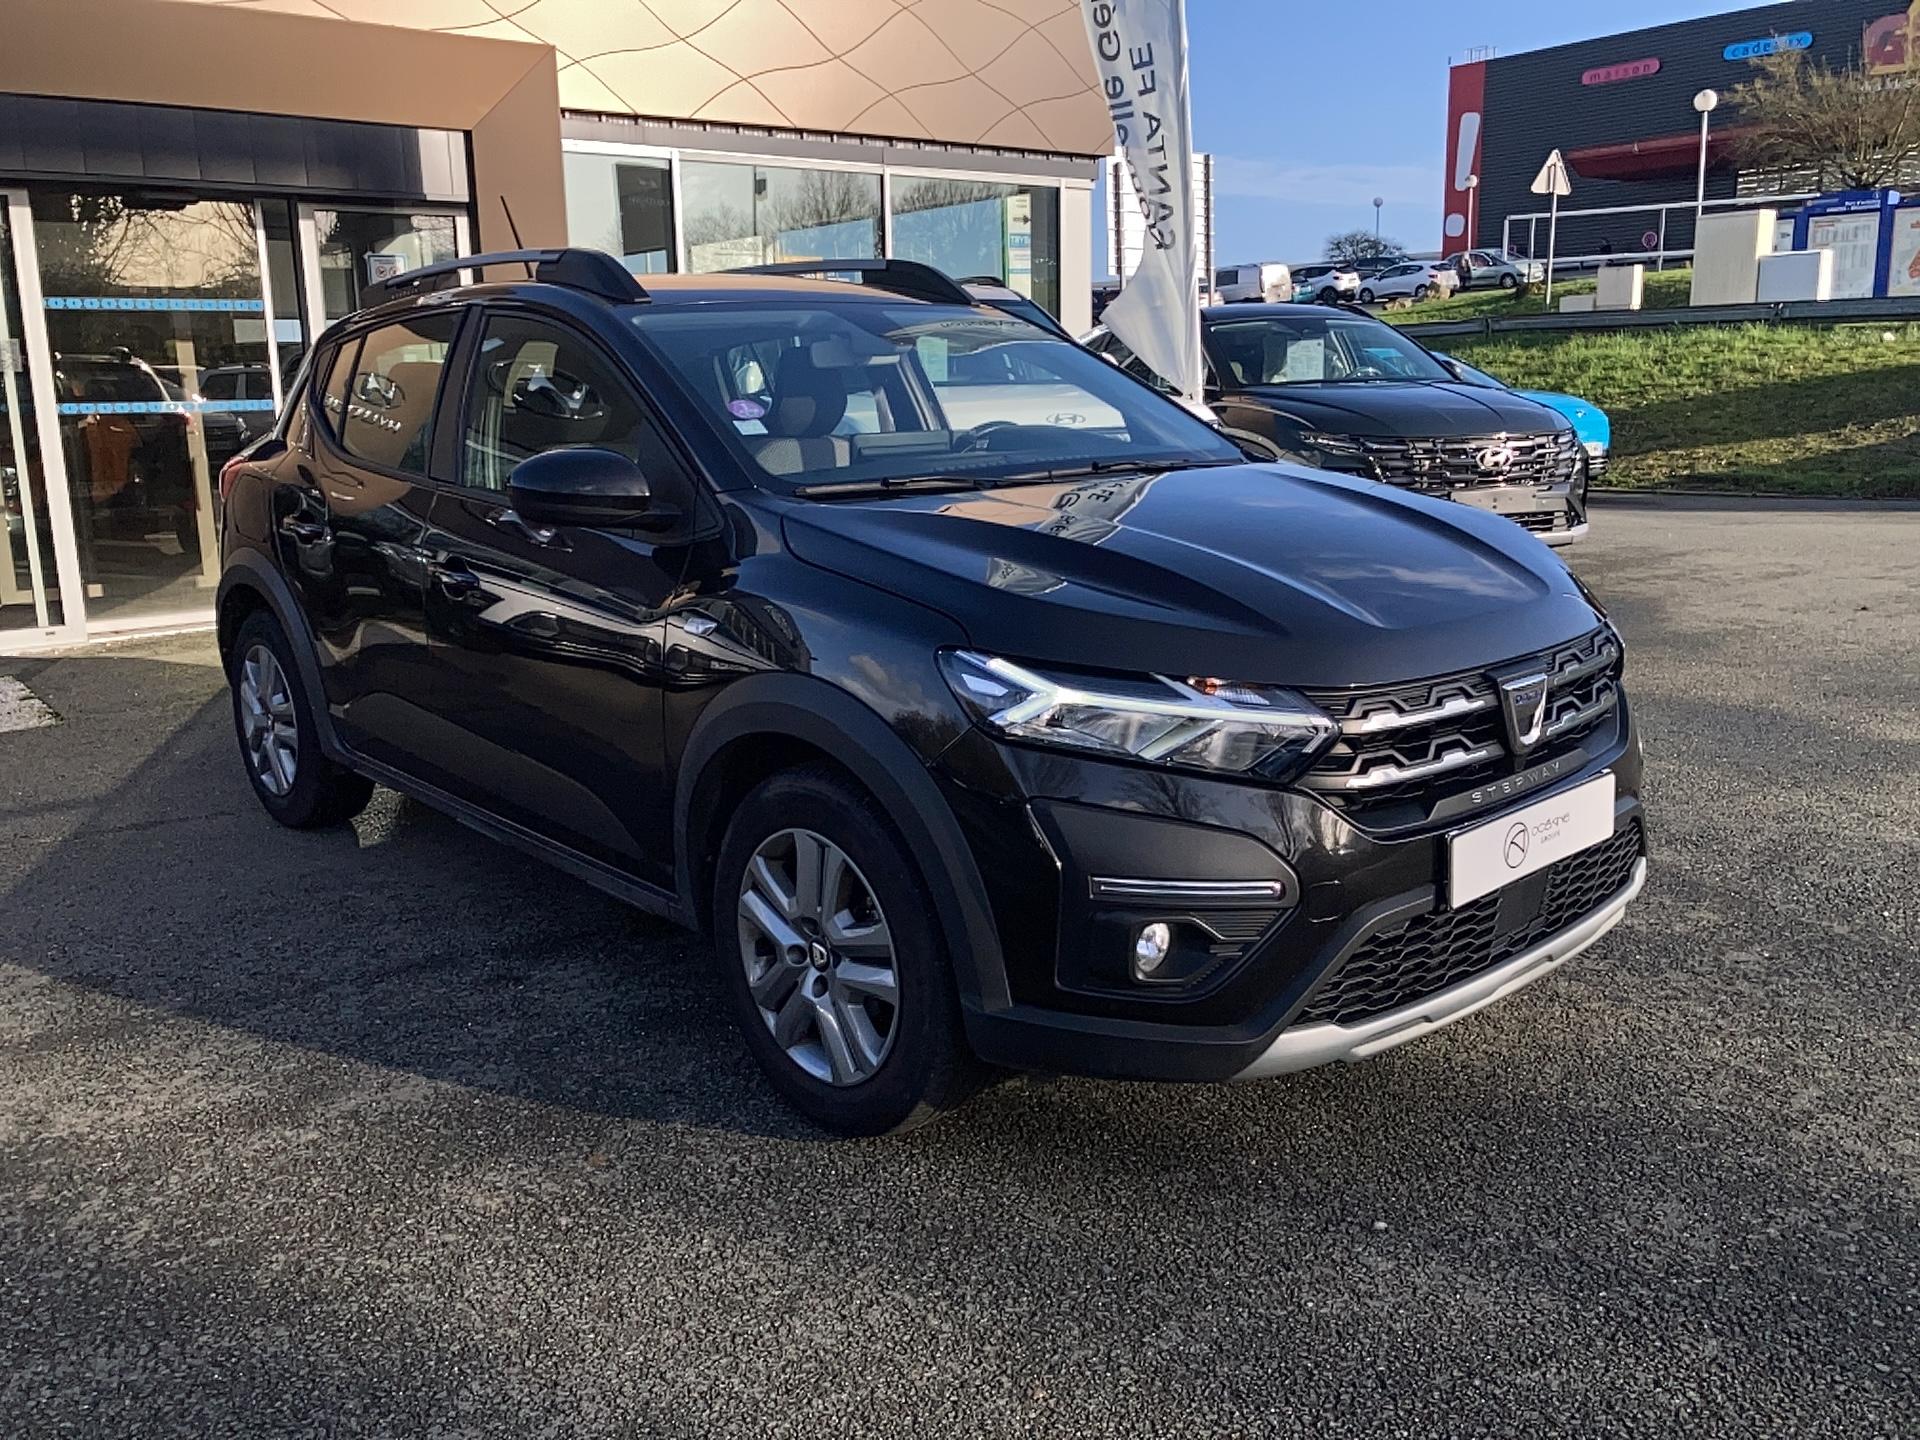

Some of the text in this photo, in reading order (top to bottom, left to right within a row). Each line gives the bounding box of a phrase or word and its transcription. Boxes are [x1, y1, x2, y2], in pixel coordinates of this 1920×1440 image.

[1731, 37, 1804, 57] cadex
[1589, 63, 1651, 82] maison
[1471, 761, 1560, 803] STEPWAY
